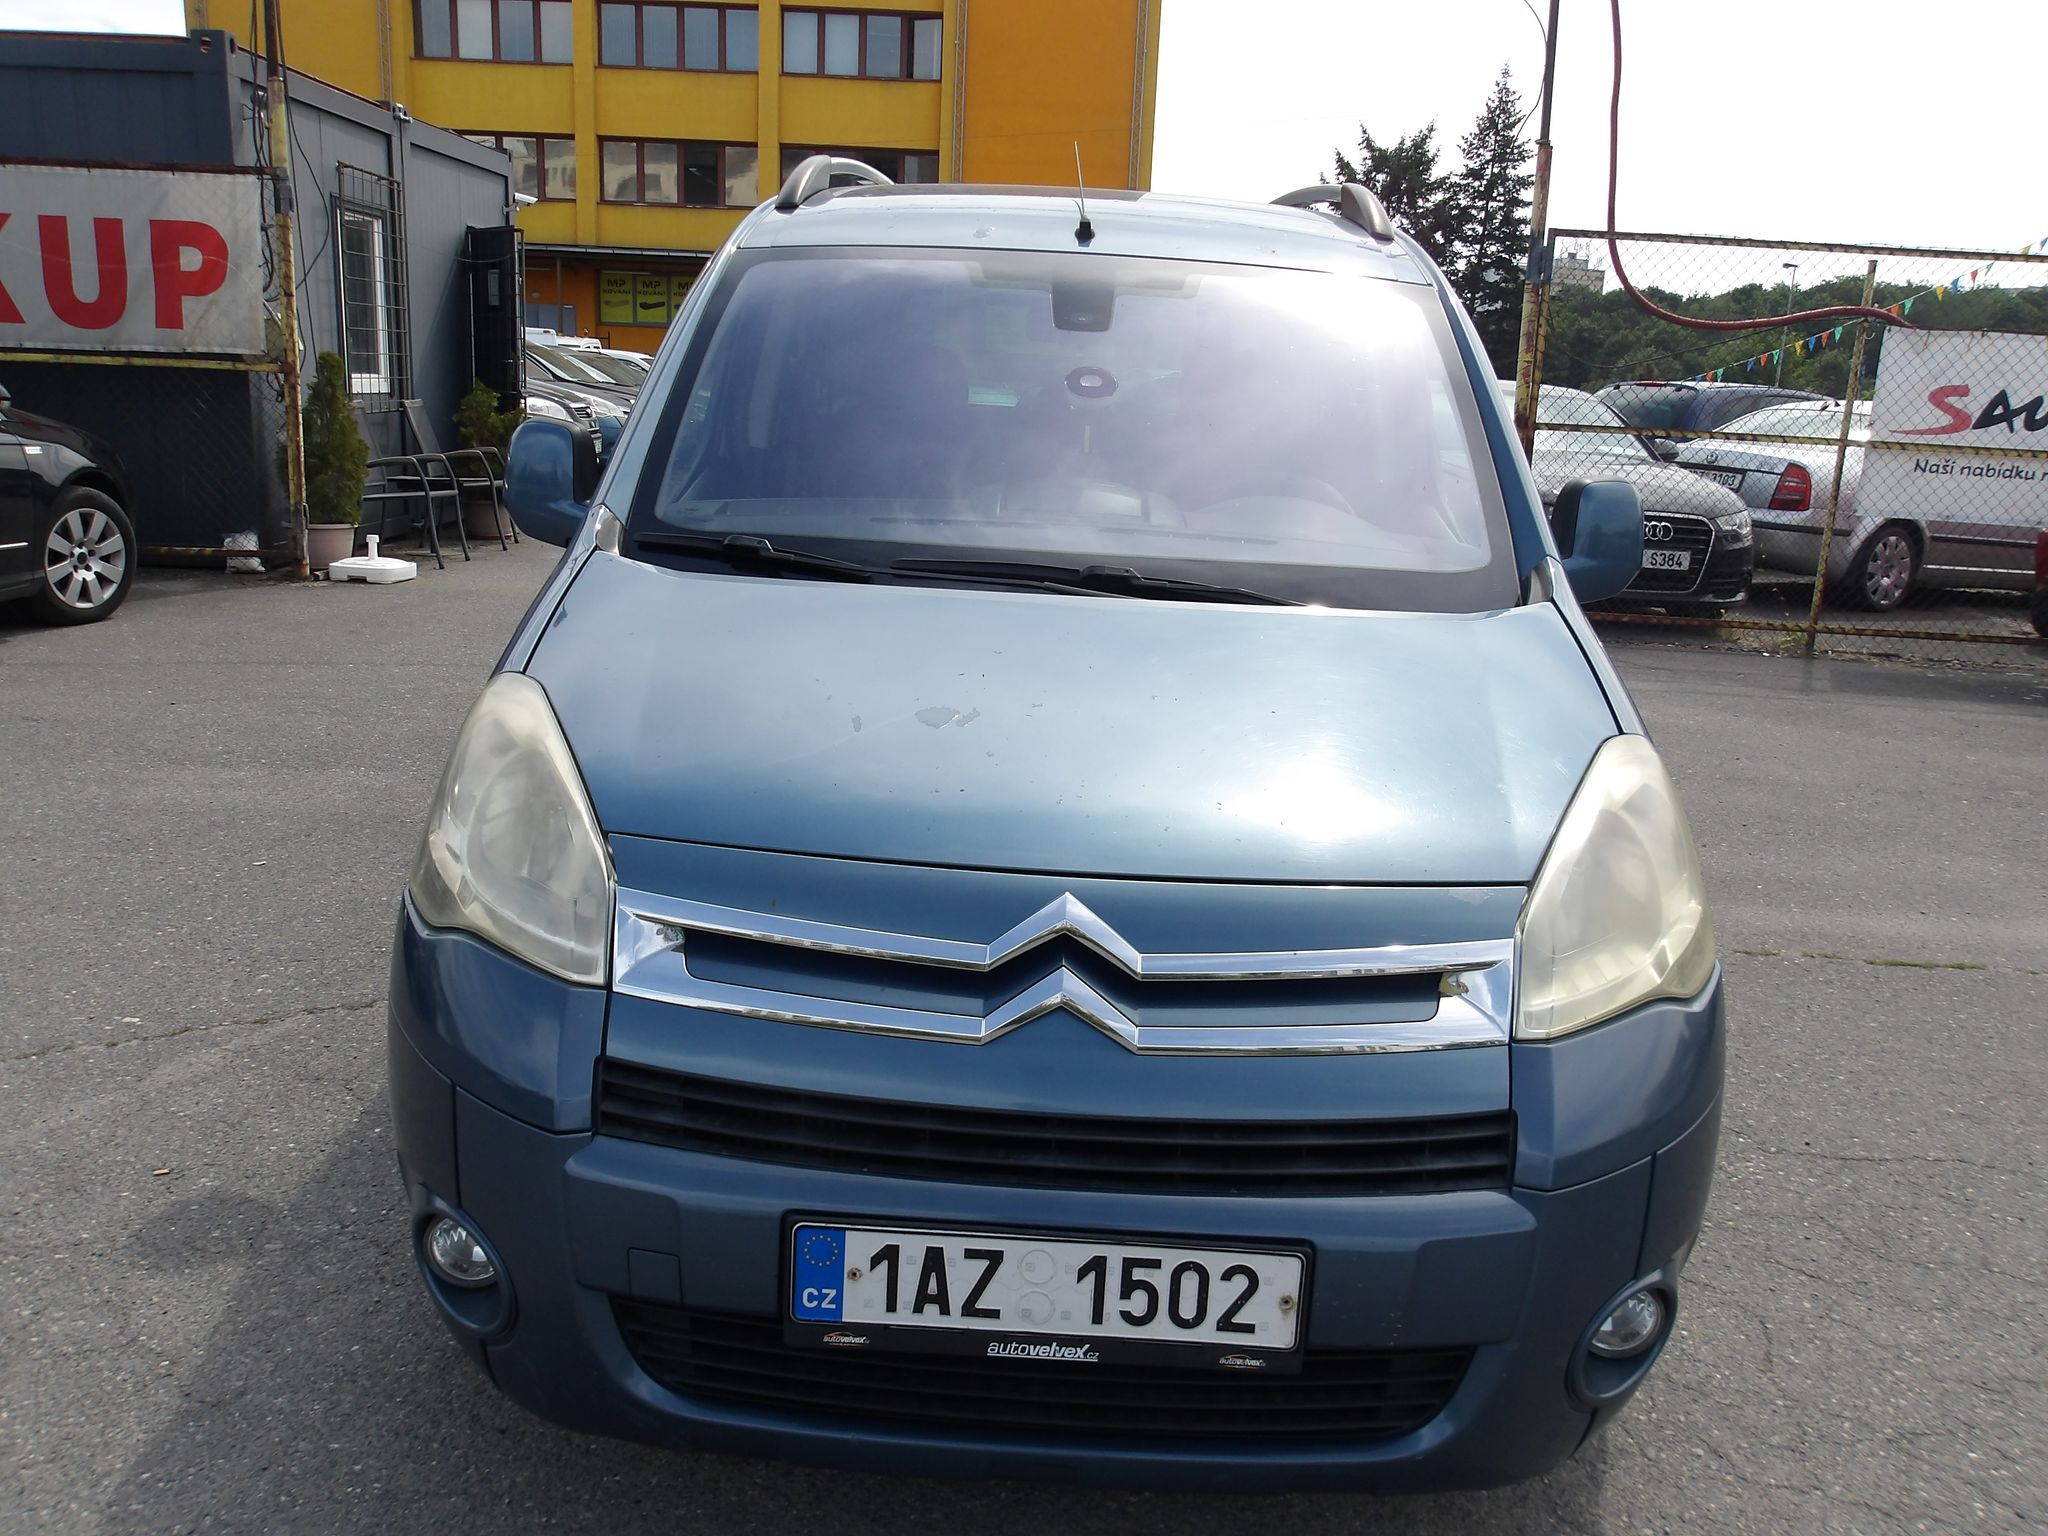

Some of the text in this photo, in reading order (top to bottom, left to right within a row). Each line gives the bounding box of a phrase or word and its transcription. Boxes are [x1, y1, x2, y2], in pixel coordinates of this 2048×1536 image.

[607, 279, 626, 288] MP
[642, 280, 661, 289] MP
[1960, 463, 2036, 480] nabídku
[1650, 552, 1682, 568] S384
[870, 1243, 1260, 1333] 1AZ 1502
[802, 1287, 837, 1309] CZ
